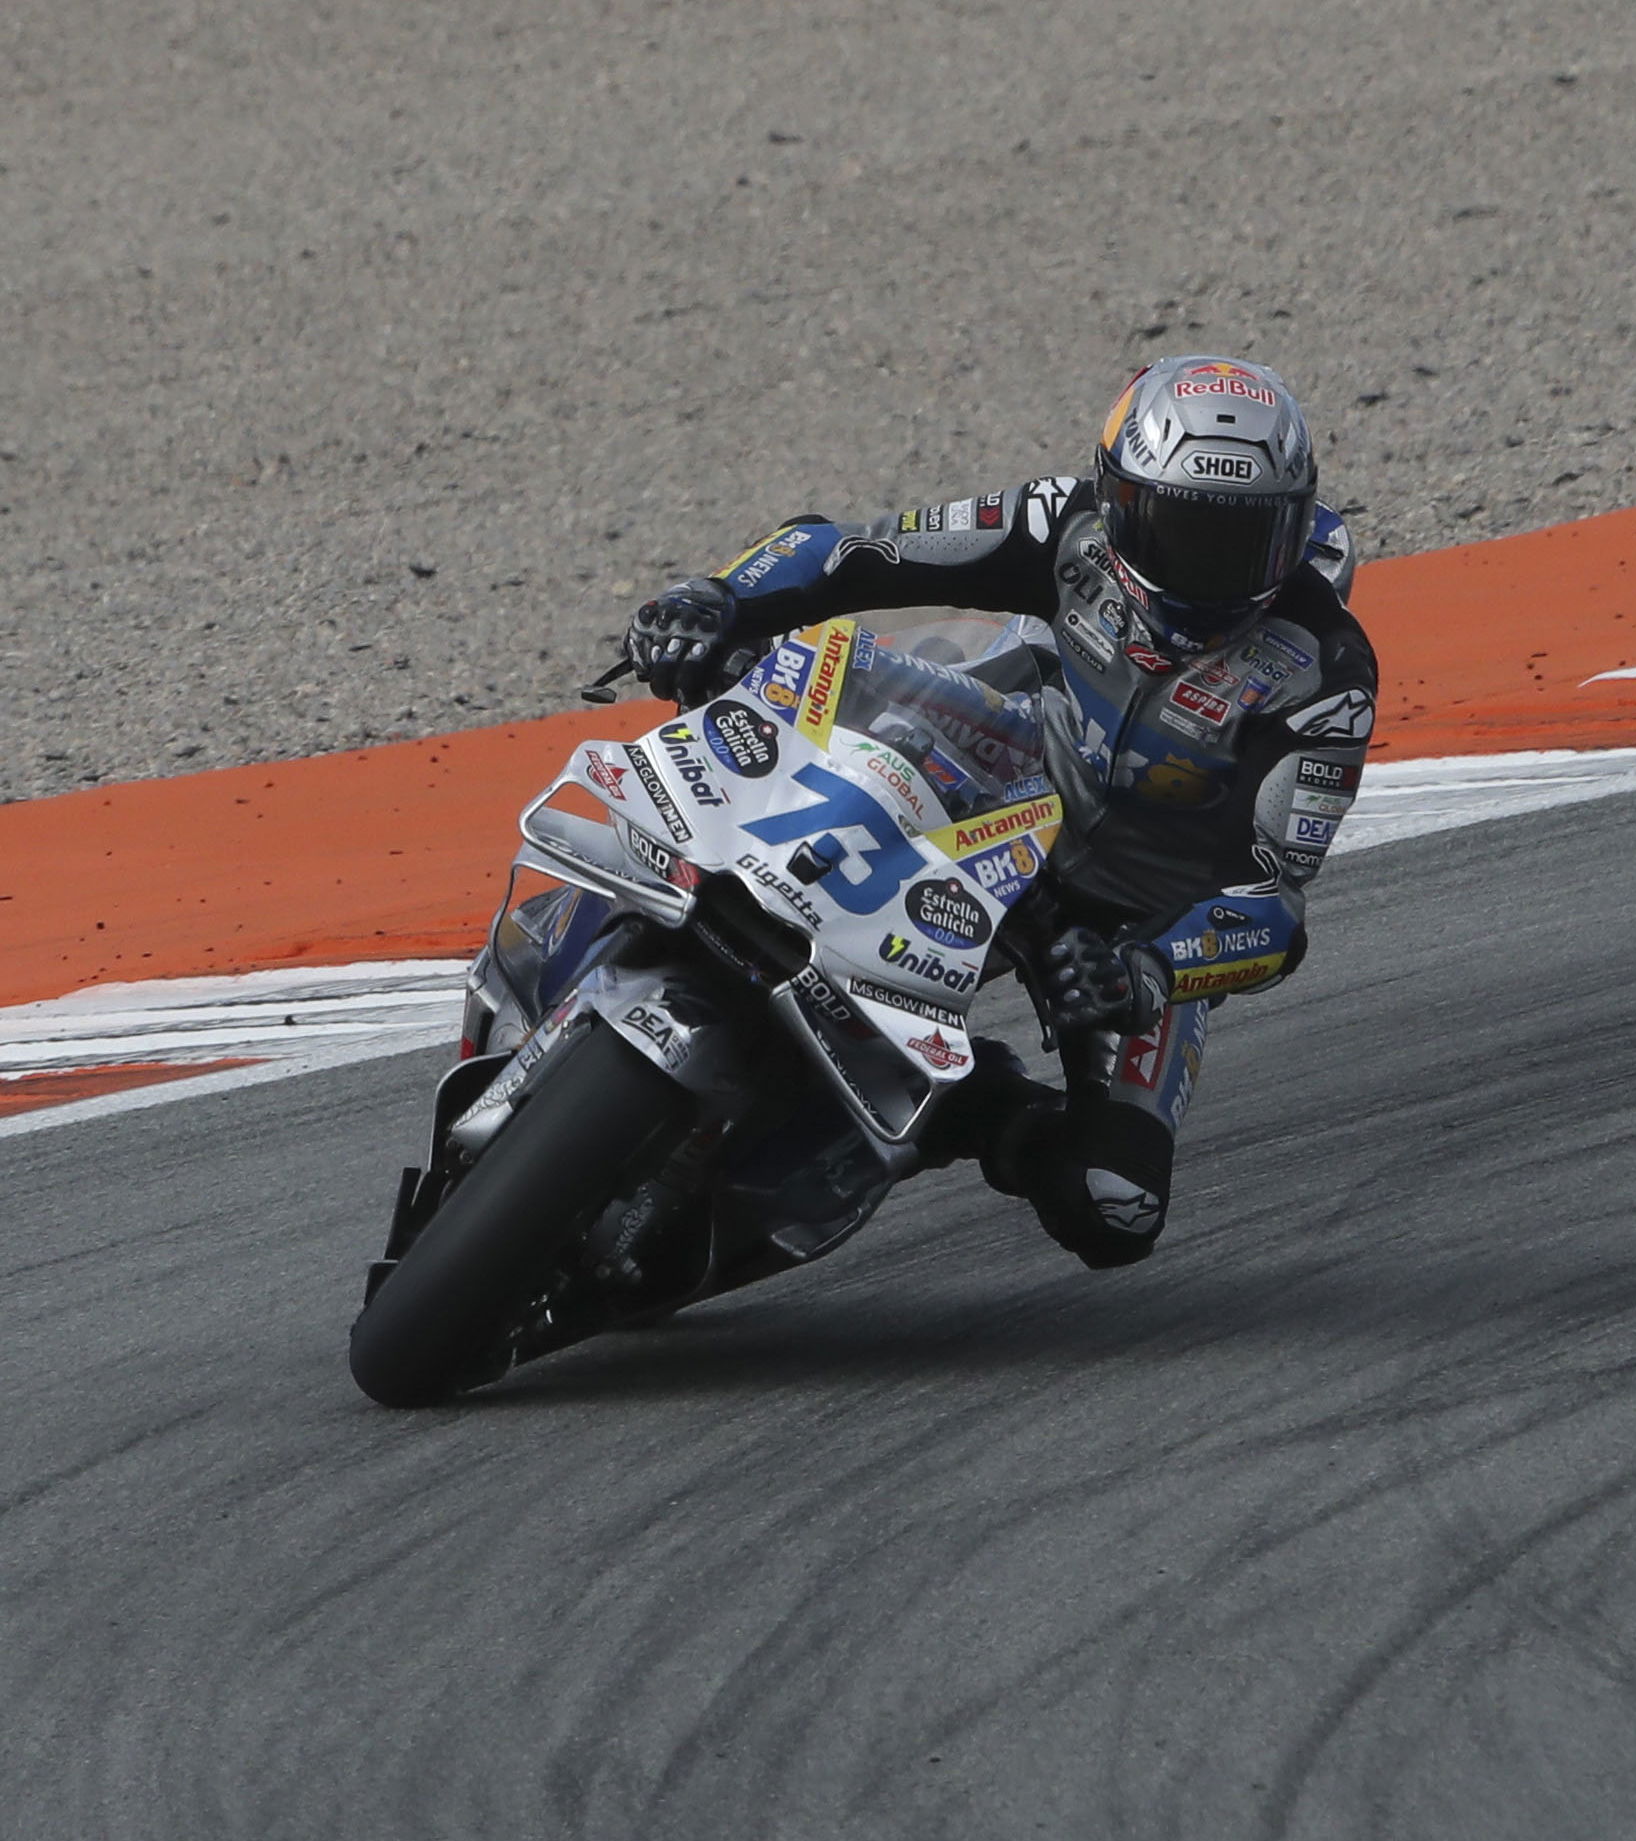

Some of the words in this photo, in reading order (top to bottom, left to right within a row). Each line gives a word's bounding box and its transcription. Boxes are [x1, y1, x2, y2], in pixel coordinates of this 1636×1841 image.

[1174, 378, 1225, 399] Red
[1227, 380, 1276, 407] Bull
[1193, 456, 1253, 479] SHOEI
[1156, 484, 1199, 502] GIVES
[1207, 494, 1237, 506] YOU
[738, 552, 784, 588] NEWS
[853, 627, 877, 671] ALEX
[761, 647, 806, 709] BK8
[805, 626, 851, 727] Antangin
[716, 716, 752, 767] Galicia
[729, 709, 769, 764] Estrella
[628, 745, 645, 768] MS
[641, 765, 669, 806] GLOW
[658, 721, 727, 808] Unibat
[877, 750, 916, 782] AUS
[1301, 760, 1344, 781] BOLD
[867, 758, 924, 821] GLOBAL
[1003, 775, 1047, 802] ALEX
[738, 762, 930, 917] 73
[955, 801, 1054, 851] Antangin
[630, 829, 671, 871] BOLD
[974, 839, 1039, 889] BK8
[921, 887, 979, 924] Estrella
[994, 880, 1021, 899] NEWS
[920, 905, 975, 939] Galicia
[1224, 928, 1271, 953] NEWS
[878, 931, 977, 994] Unibat
[1174, 963, 1269, 993] Antangin
[797, 966, 850, 1021] BOLD
[851, 979, 874, 998] MS
[874, 986, 917, 1012] GLOW
[908, 1039, 948, 1060] FEDERAL
